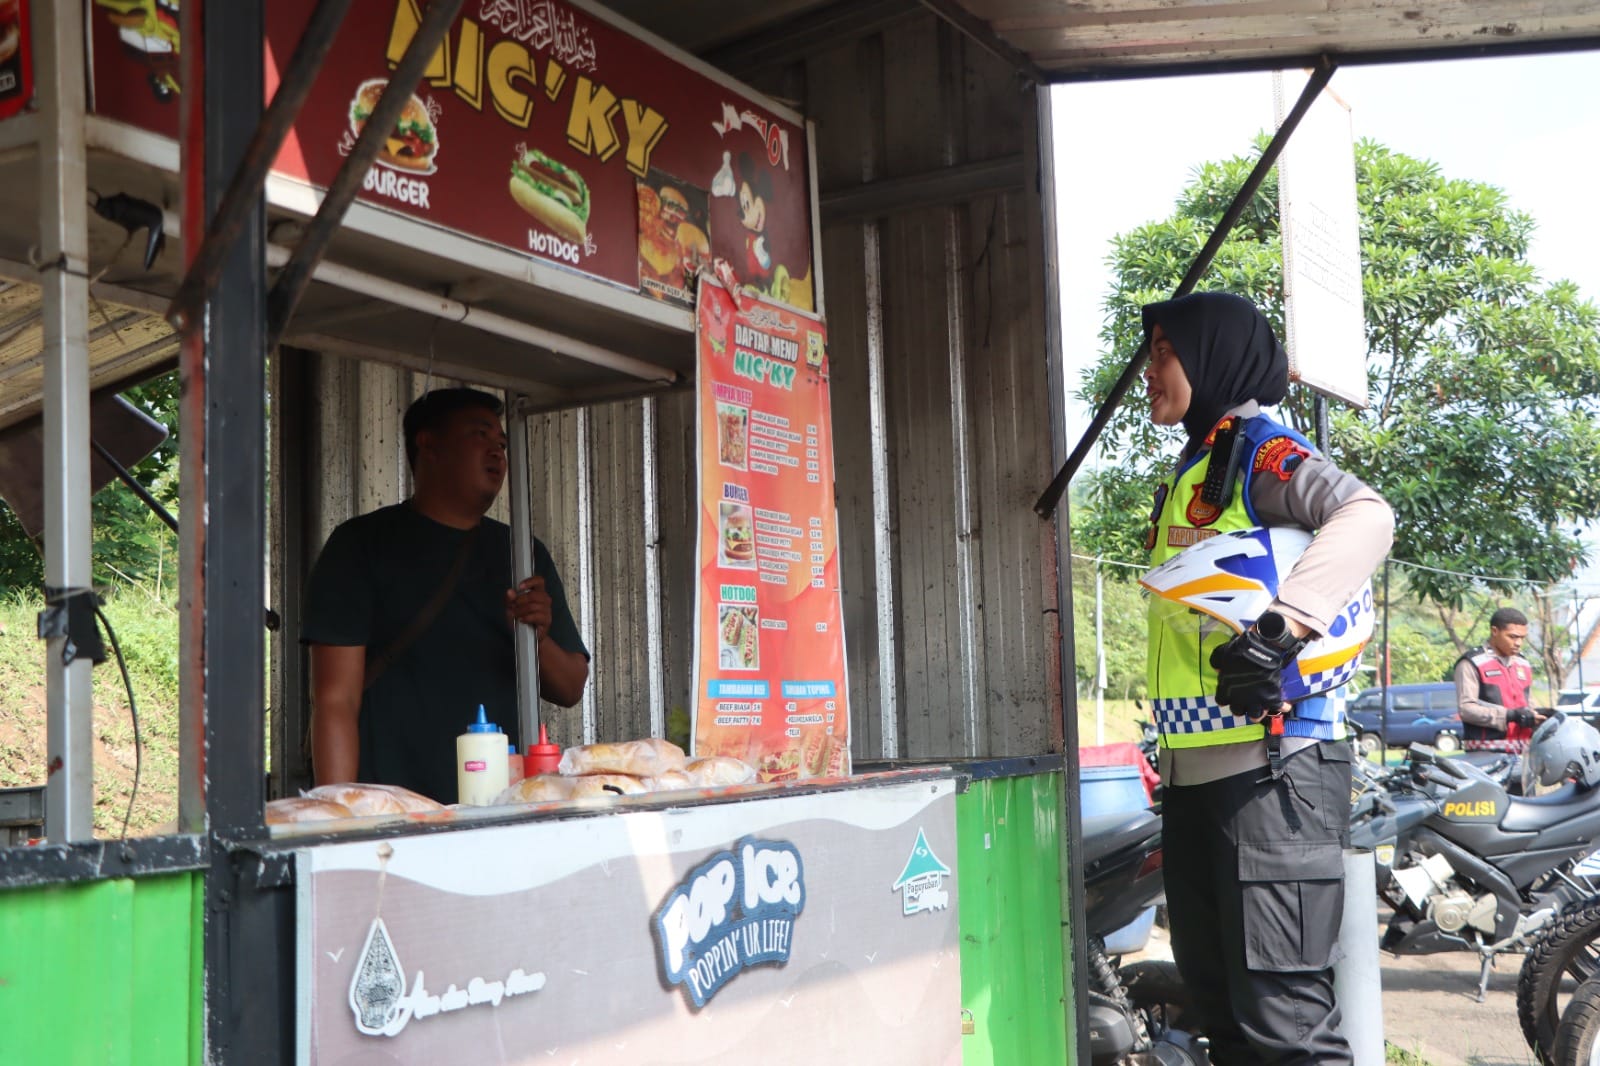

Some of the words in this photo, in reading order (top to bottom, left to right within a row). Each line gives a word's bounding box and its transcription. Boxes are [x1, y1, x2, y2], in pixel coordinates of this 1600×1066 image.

[363, 167, 430, 209] BURGER
[528, 229, 580, 264] HOTDOG
[736, 324, 770, 353] DAFTAR
[770, 336, 798, 362] MENU
[721, 586, 756, 601] HOTDOG
[1444, 801, 1496, 817] POLISI
[907, 876, 938, 895] Paguyuban
[688, 929, 740, 998] POPPIN'
[742, 922, 761, 957] UR
[763, 919, 790, 954] LIFE!
